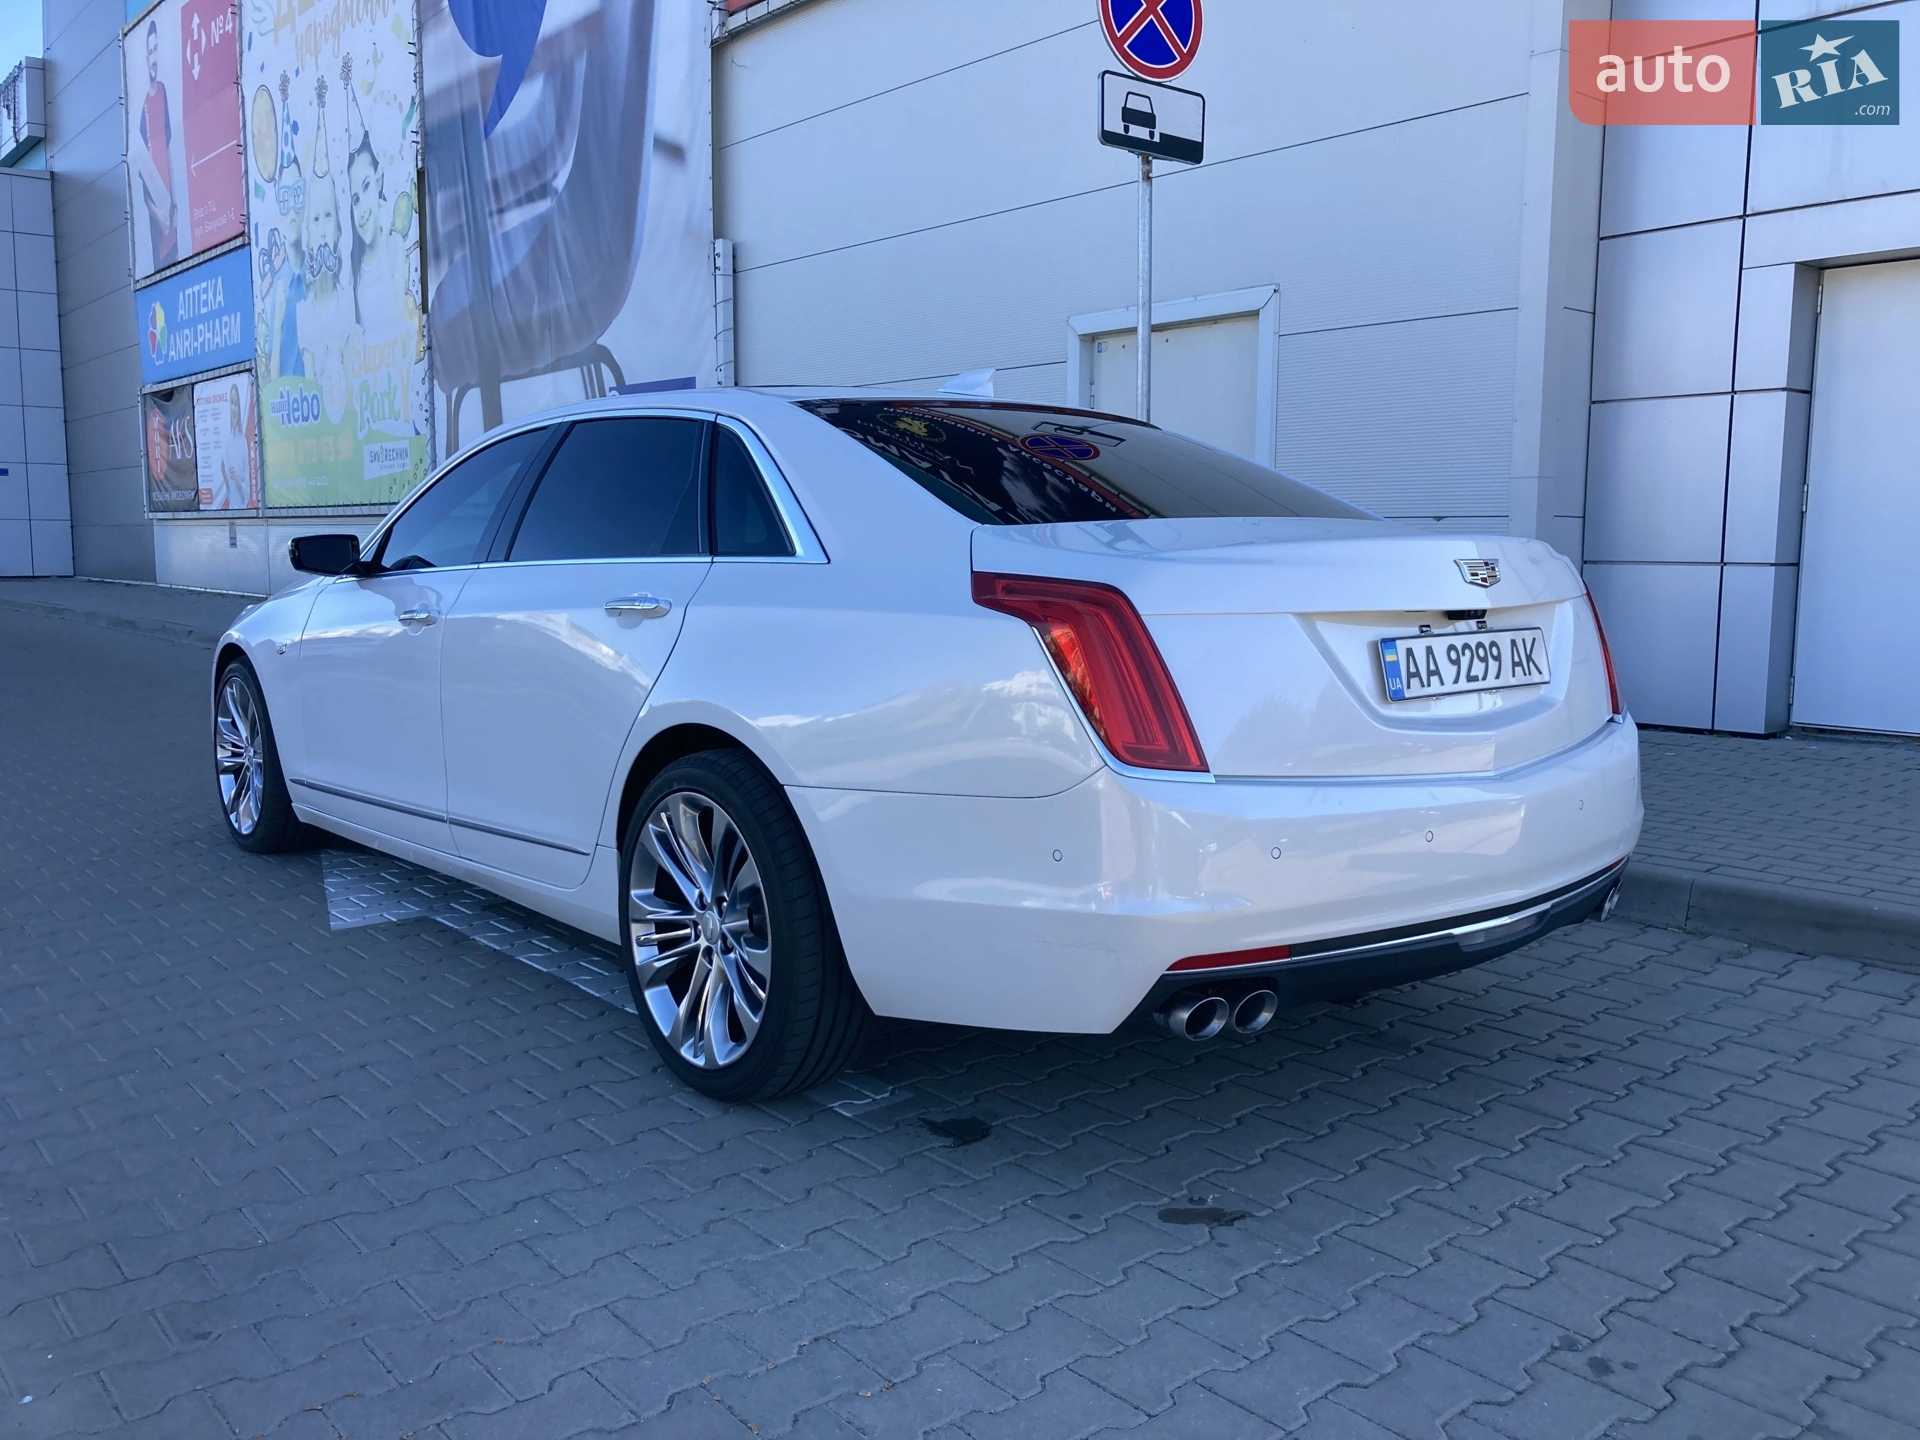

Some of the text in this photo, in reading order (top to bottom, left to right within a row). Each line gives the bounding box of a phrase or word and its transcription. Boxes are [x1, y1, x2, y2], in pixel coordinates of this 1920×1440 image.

[178, 275, 225, 323] АПТЕКА
[168, 311, 242, 363] ANRI-PHARM
[279, 386, 321, 426] Nebo
[1388, 677, 1403, 691] UA
[1406, 636, 1543, 690] AA 9299 AK
